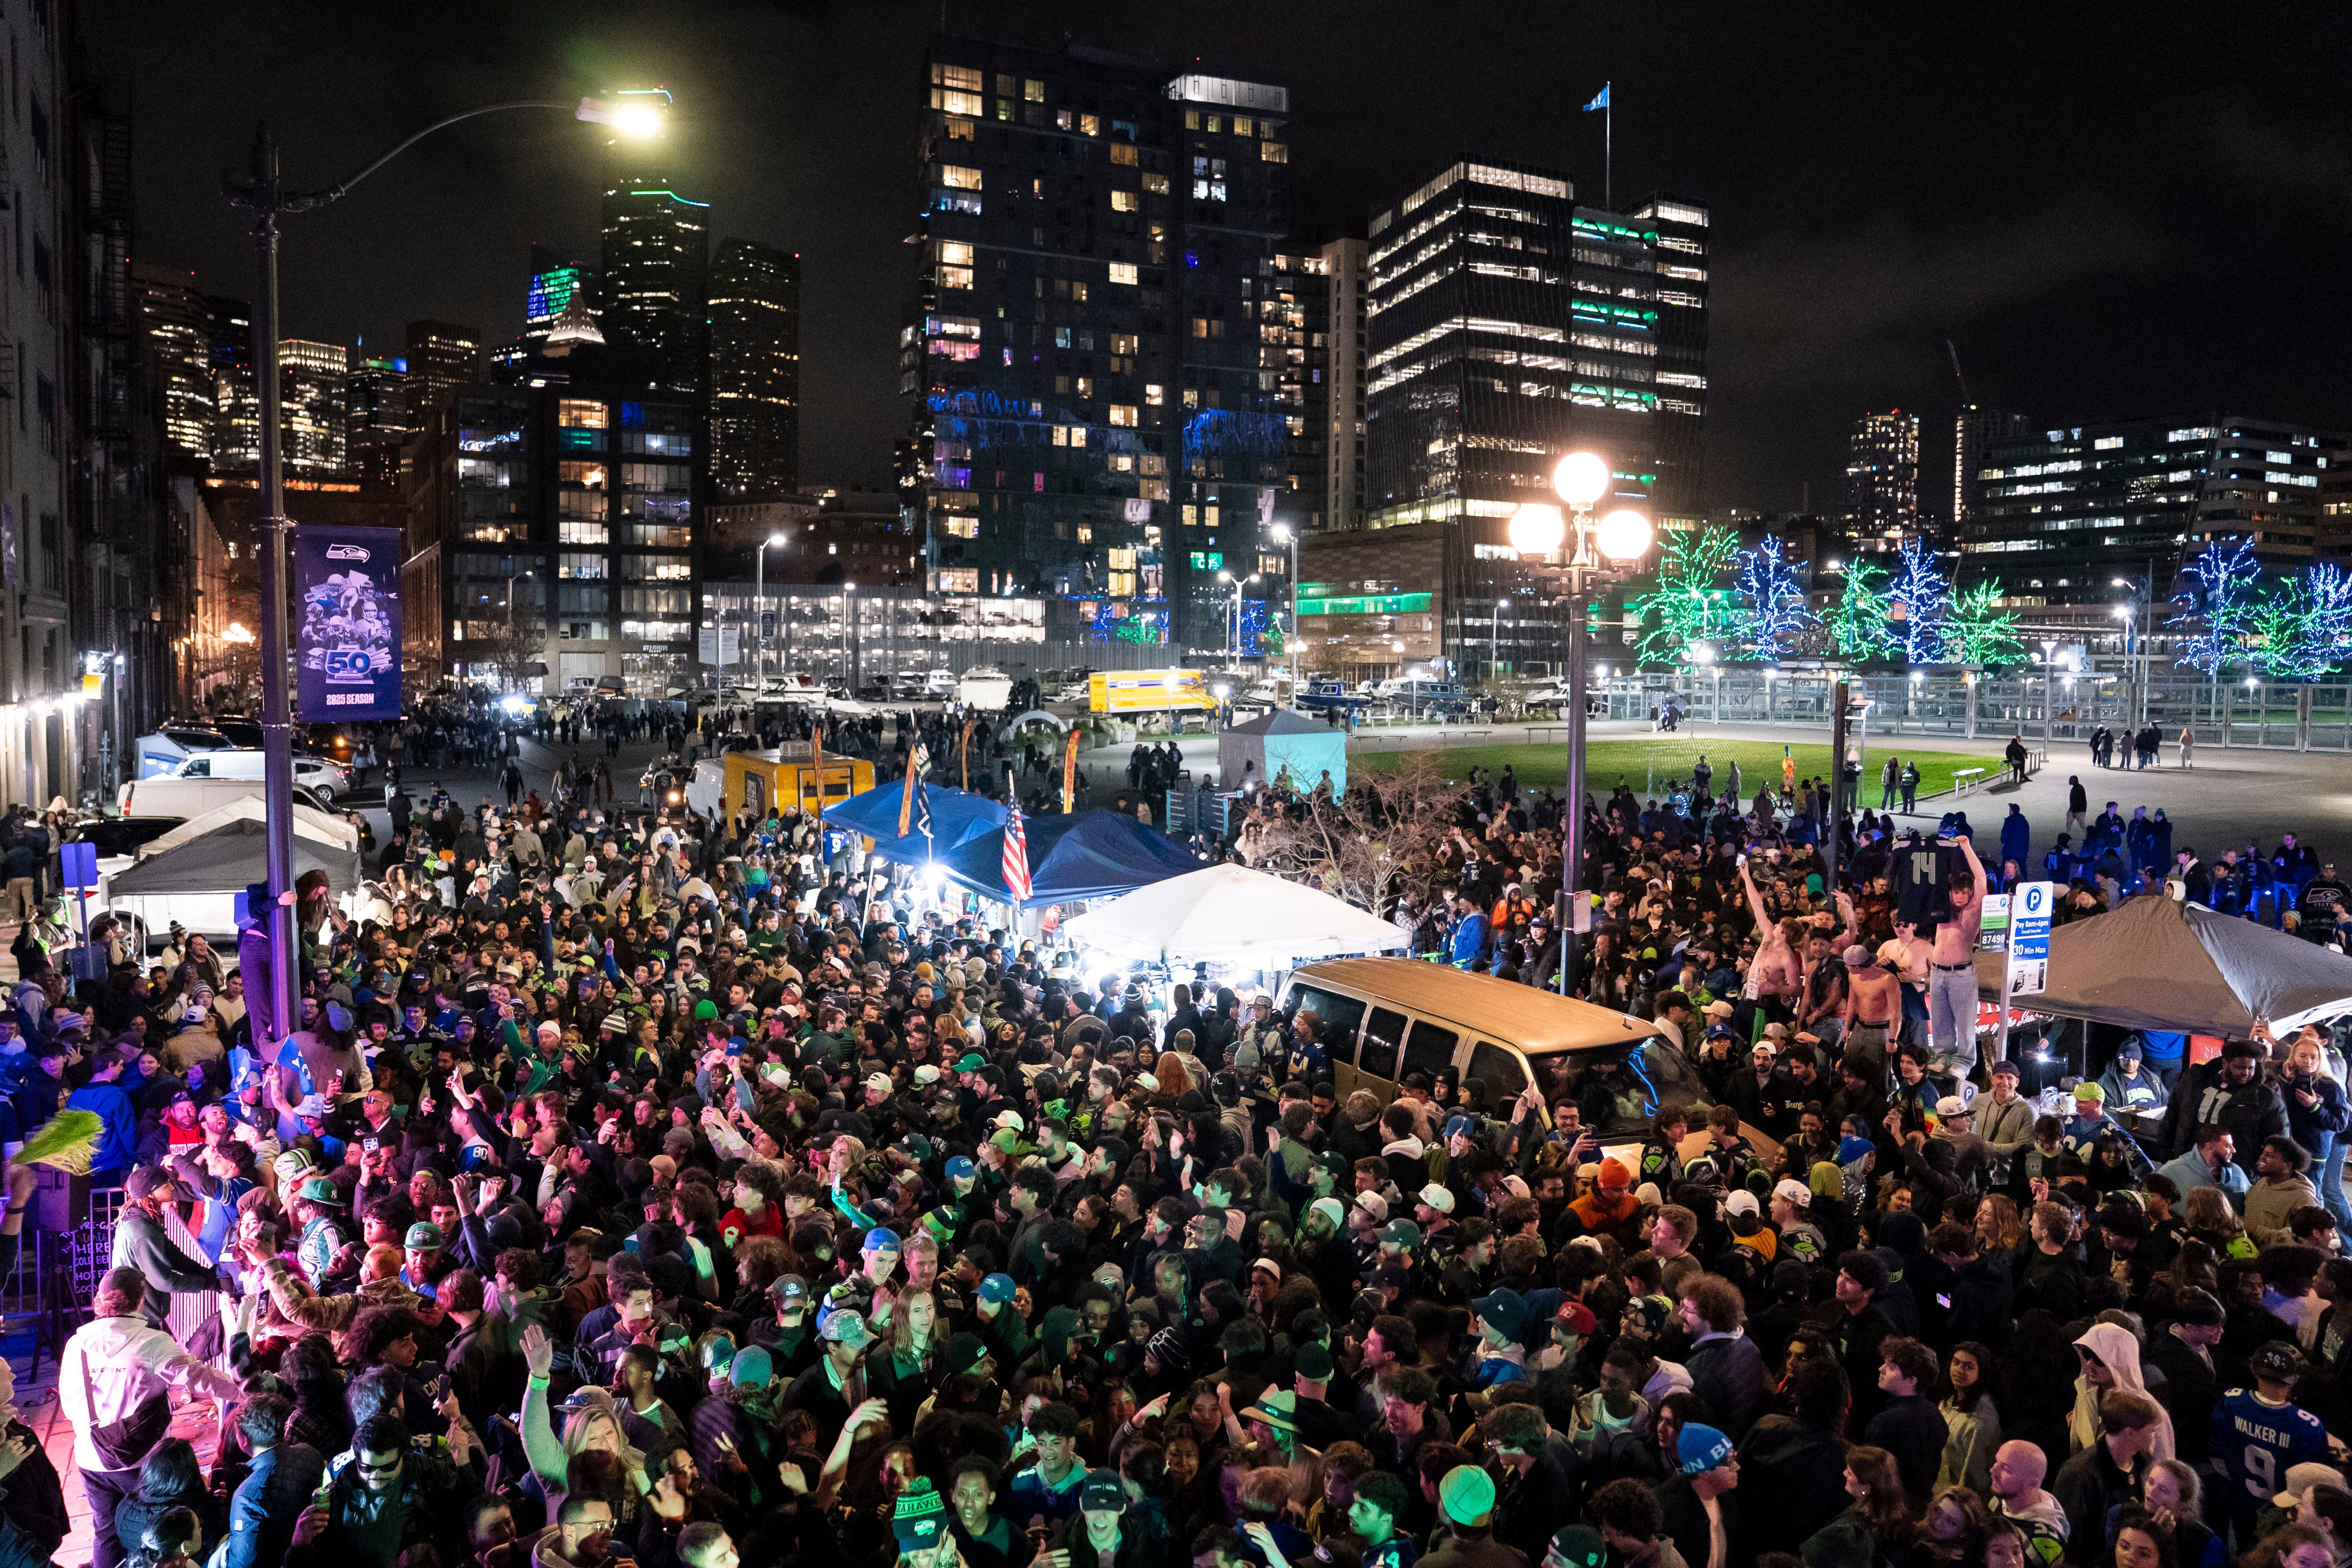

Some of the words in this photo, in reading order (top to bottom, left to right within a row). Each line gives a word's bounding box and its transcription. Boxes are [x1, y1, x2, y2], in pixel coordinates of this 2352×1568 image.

[1949, 639, 1962, 662] 3
[327, 652, 371, 674] 50
[326, 694, 345, 705] 2025
[346, 693, 374, 704] SEASON
[439, 799, 450, 812] 54
[832, 838, 841, 854] 9
[1470, 869, 1479, 881] 12
[1911, 852, 1936, 885] 14
[589, 881, 600, 896] 11
[2030, 892, 2040, 908] P
[2025, 920, 2049, 928] 8am-6pm
[1982, 934, 2005, 944] 87498
[2014, 944, 2024, 956] 30
[404, 1042, 433, 1068] 25
[1966, 1089, 1972, 1100] P
[2198, 1086, 2232, 1125] 11
[473, 1147, 488, 1160] 80
[76, 1242, 110, 1254] HERE
[2242, 1241, 2253, 1253] 3
[2225, 1388, 2244, 1397] 9
[2298, 1408, 2319, 1427] 9
[2234, 1415, 2276, 1443] WALKER
[2279, 1432, 2291, 1448] III
[2244, 1444, 2277, 1500] 9
